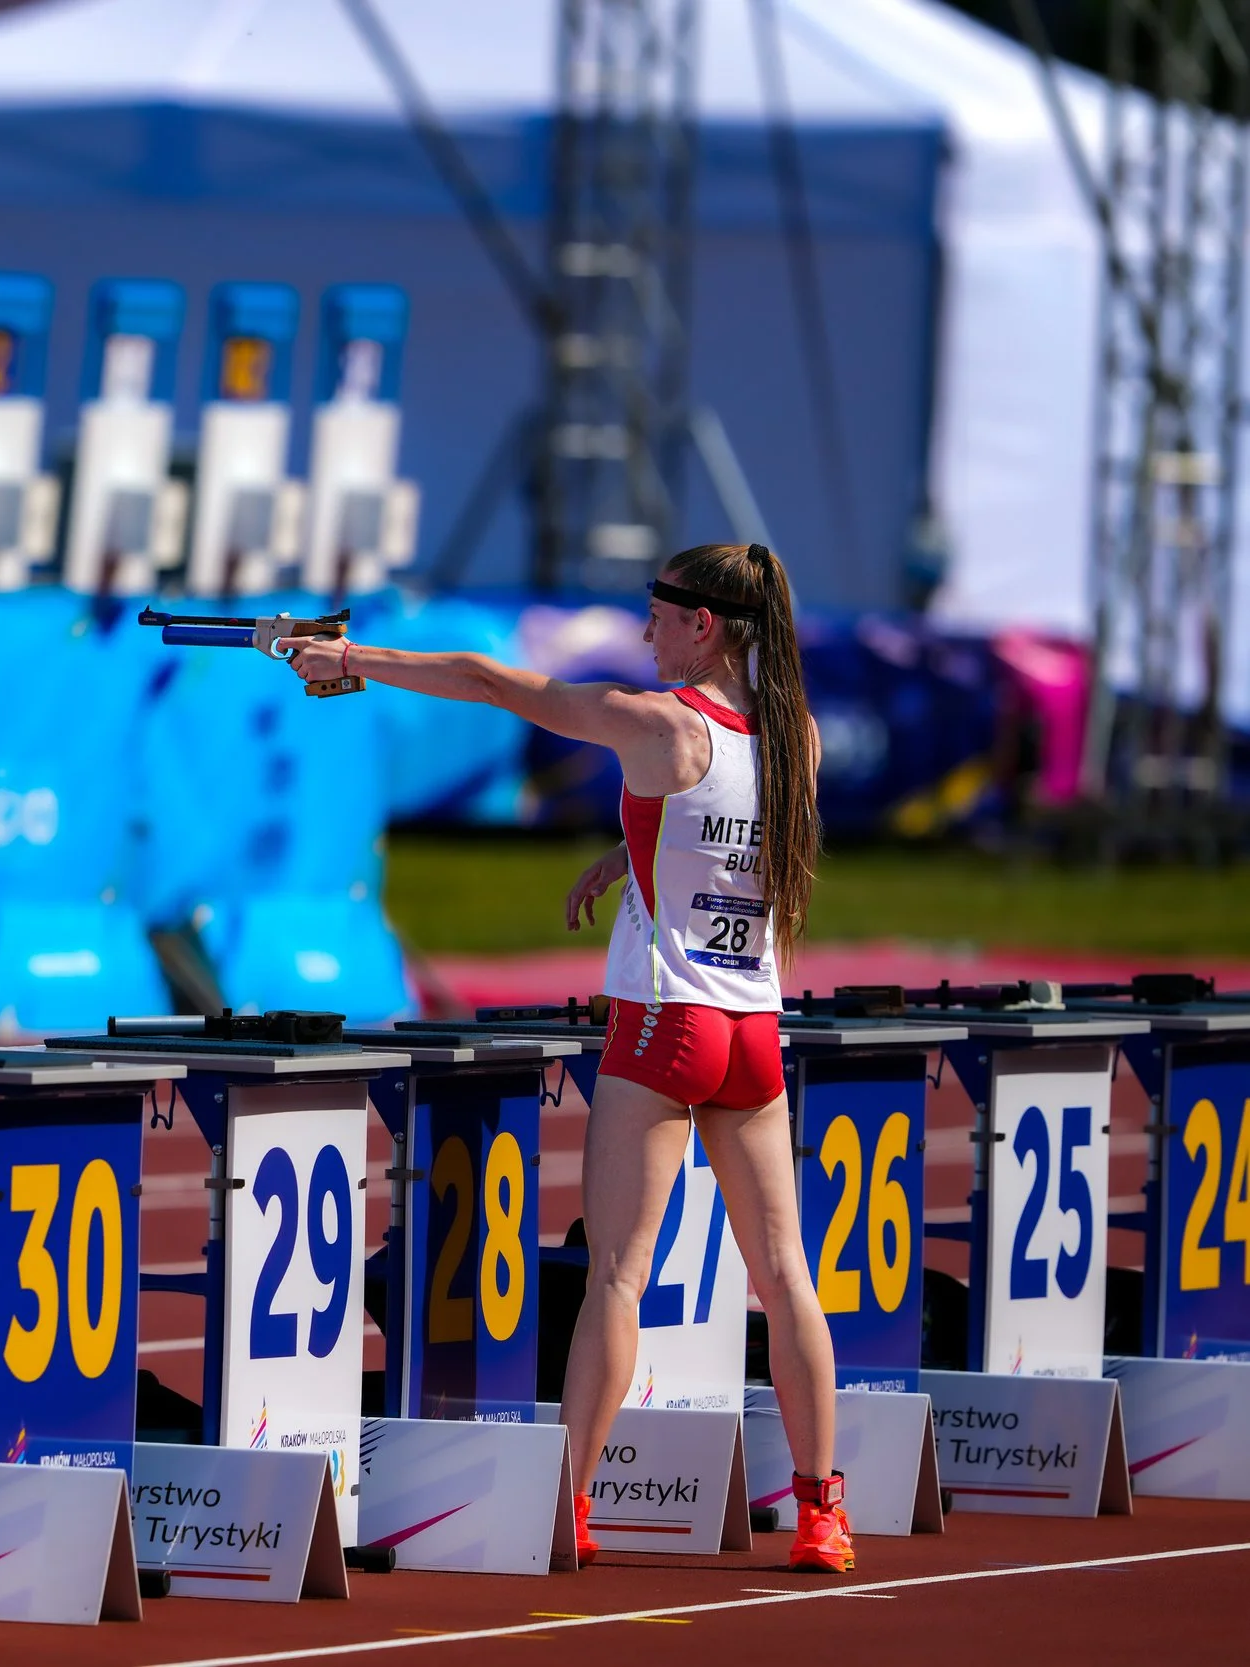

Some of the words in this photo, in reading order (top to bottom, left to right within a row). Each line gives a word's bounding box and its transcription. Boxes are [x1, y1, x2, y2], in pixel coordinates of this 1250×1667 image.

[706, 896, 733, 905] European
[733, 899, 751, 907] Games
[706, 916, 750, 953] 28
[722, 958, 740, 966] ORLEN
[1010, 1106, 1093, 1302] 25
[1179, 1098, 1250, 1291] 24
[639, 1126, 727, 1329] 27
[816, 1112, 910, 1315] 26
[250, 1144, 352, 1361] 29
[428, 1132, 526, 1343] 28
[3, 1159, 123, 1383] 30
[280, 1430, 308, 1448] KRAKÓW
[309, 1430, 347, 1445] MAŁOPOLSKA
[950, 1438, 1078, 1472] Turystyki
[40, 1450, 71, 1466] KRAKÓW
[72, 1451, 117, 1467] MAŁOPOLSKA
[133, 1481, 221, 1507] rstwo
[146, 1516, 282, 1553] Turystyki
